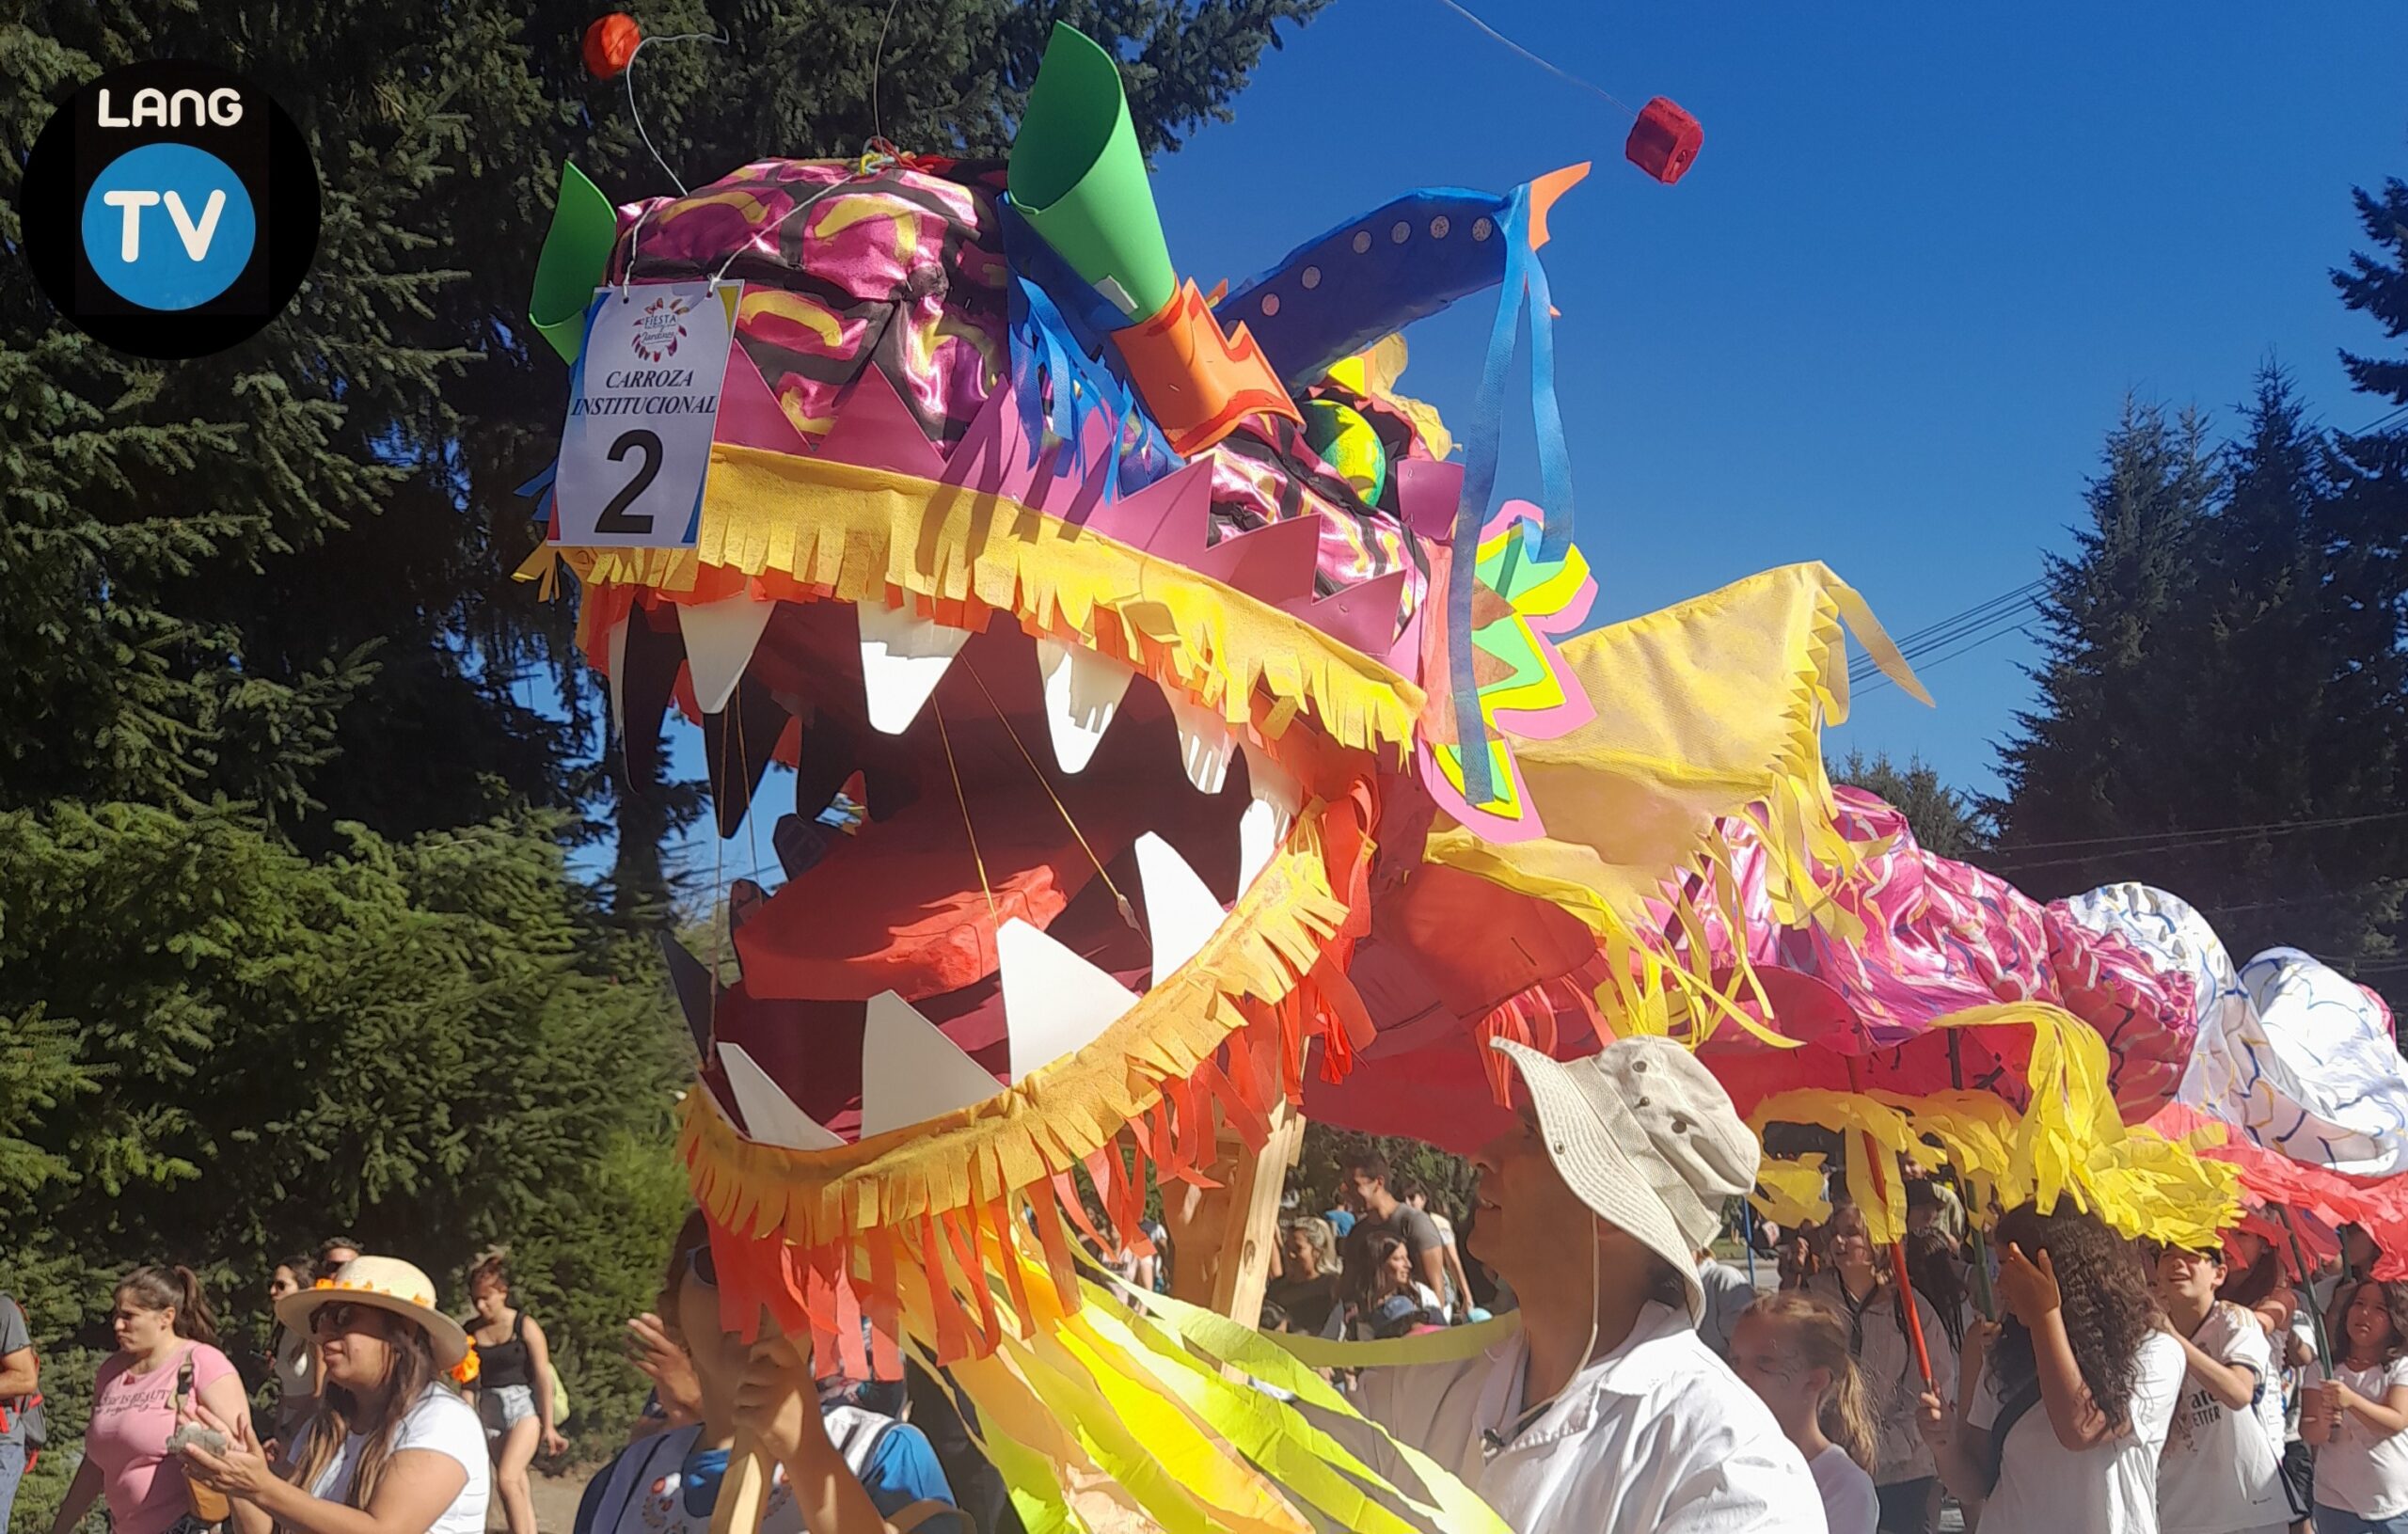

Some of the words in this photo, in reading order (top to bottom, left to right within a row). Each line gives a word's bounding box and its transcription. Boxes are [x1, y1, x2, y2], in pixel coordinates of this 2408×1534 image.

[606, 370, 694, 388] CARROZA
[570, 395, 718, 416] INSTITUCIONAL
[594, 429, 663, 534] 2
